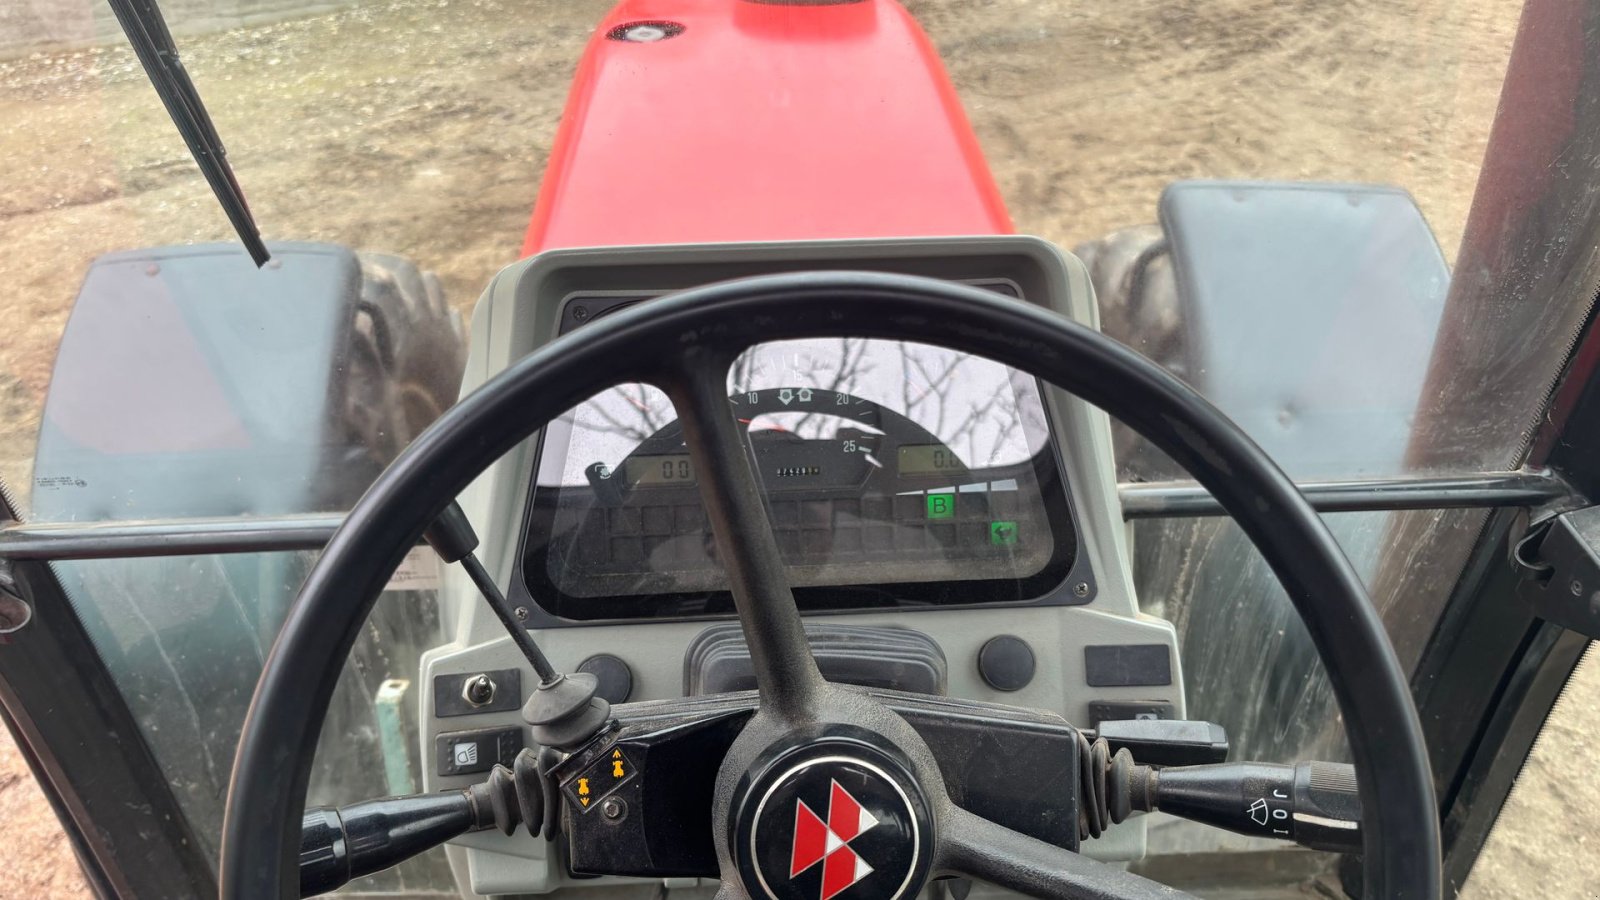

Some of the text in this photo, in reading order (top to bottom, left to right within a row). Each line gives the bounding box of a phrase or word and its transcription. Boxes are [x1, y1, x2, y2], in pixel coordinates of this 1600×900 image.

[747, 391, 758, 404] 10
[836, 393, 849, 406] 20
[843, 440, 856, 453] 25
[933, 497, 947, 514] B
